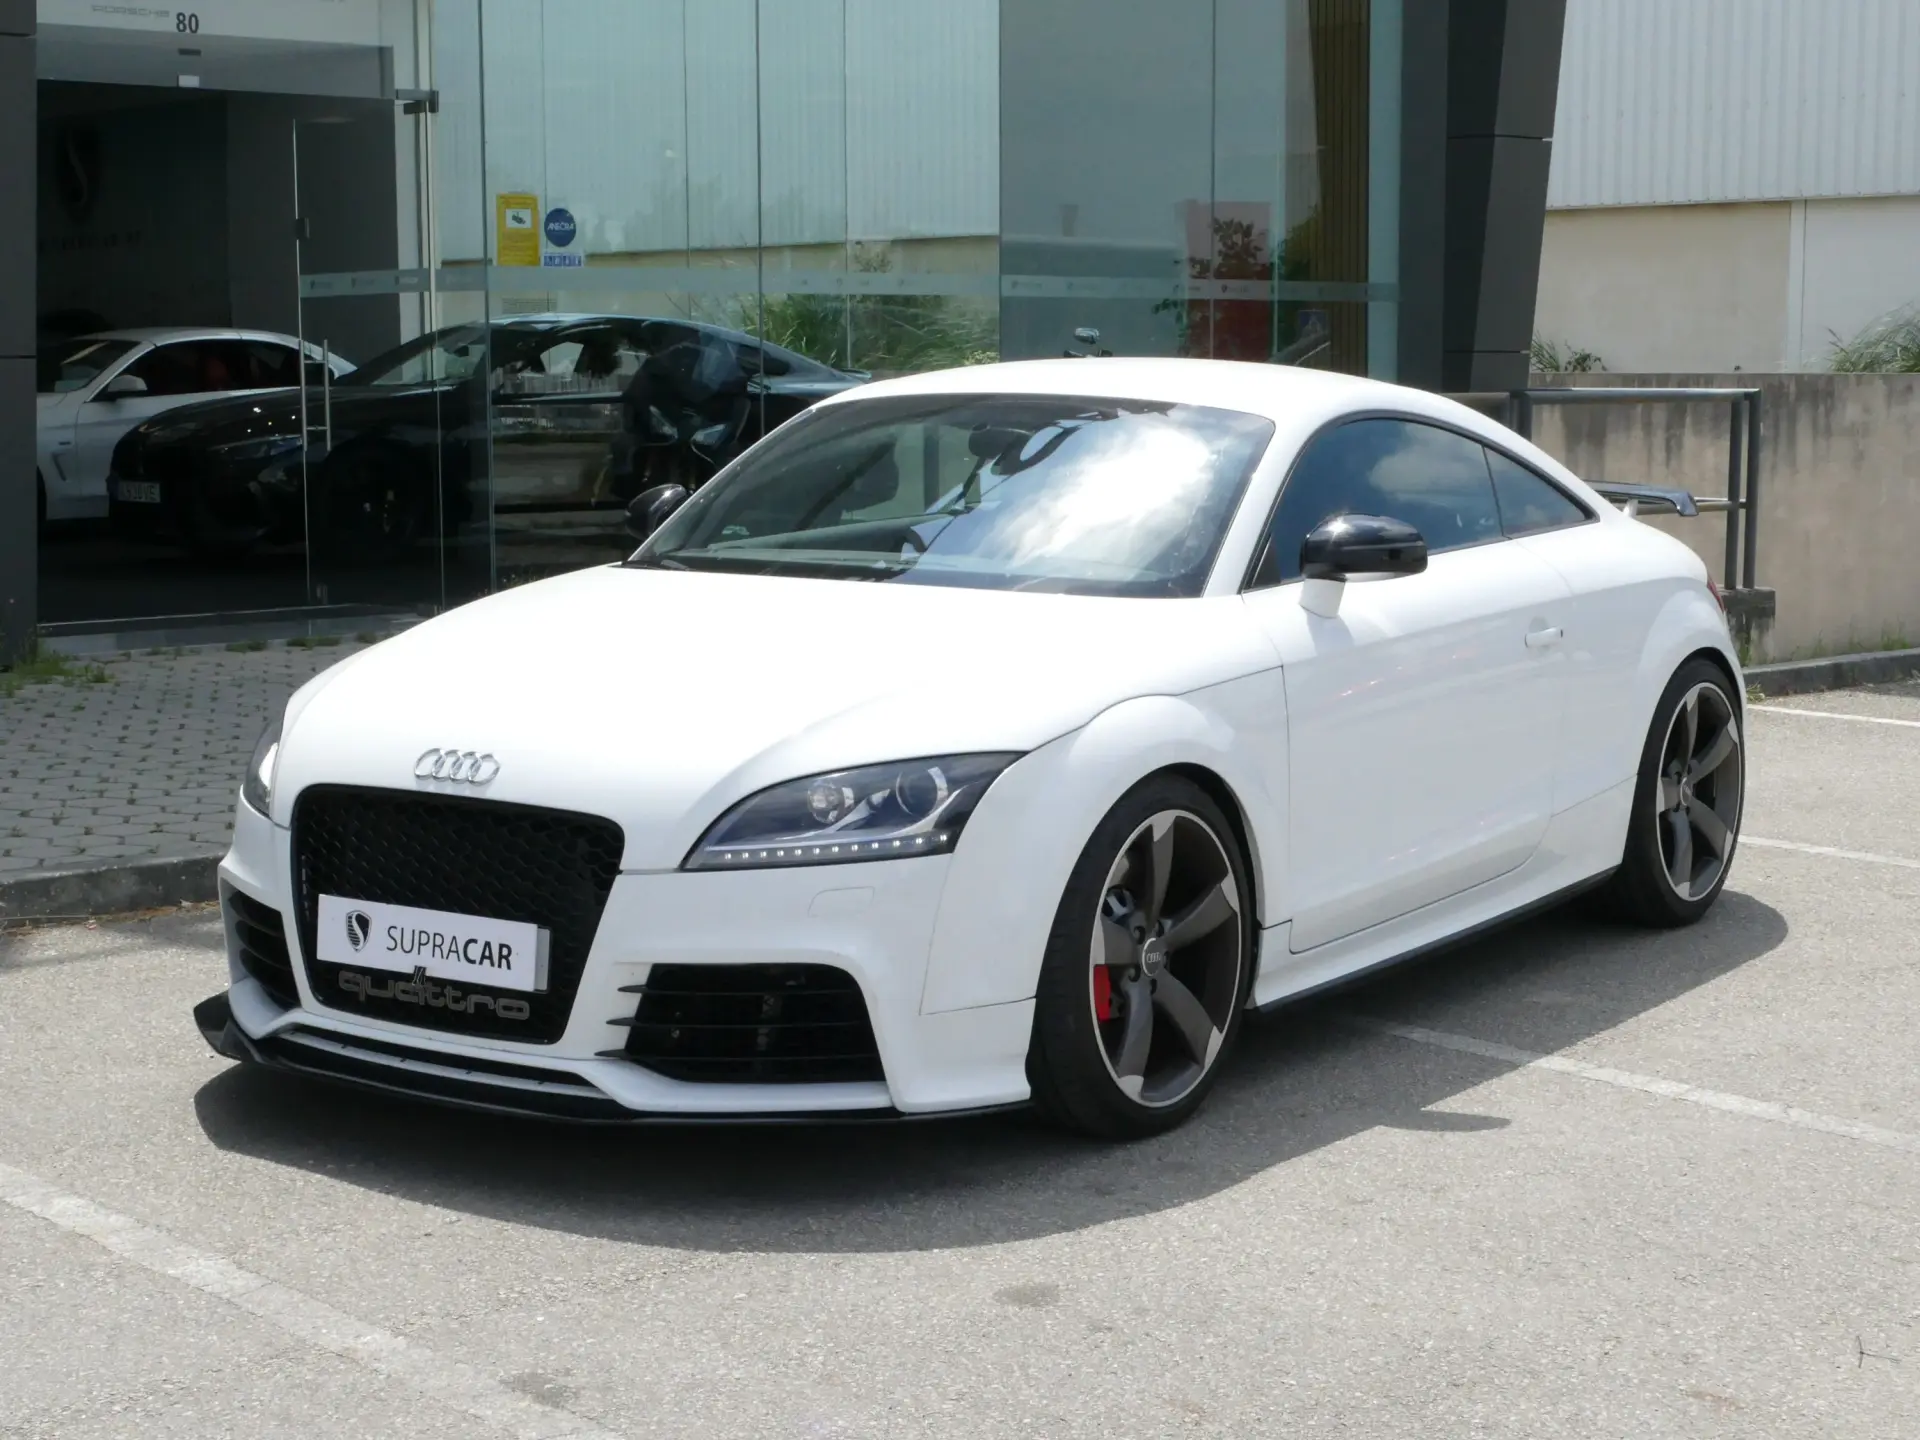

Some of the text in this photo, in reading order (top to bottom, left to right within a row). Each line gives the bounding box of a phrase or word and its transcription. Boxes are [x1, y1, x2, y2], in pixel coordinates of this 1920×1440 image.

[176, 12, 199, 34] 80
[386, 925, 513, 971] SUPRACAR
[338, 970, 530, 1021] quattro
